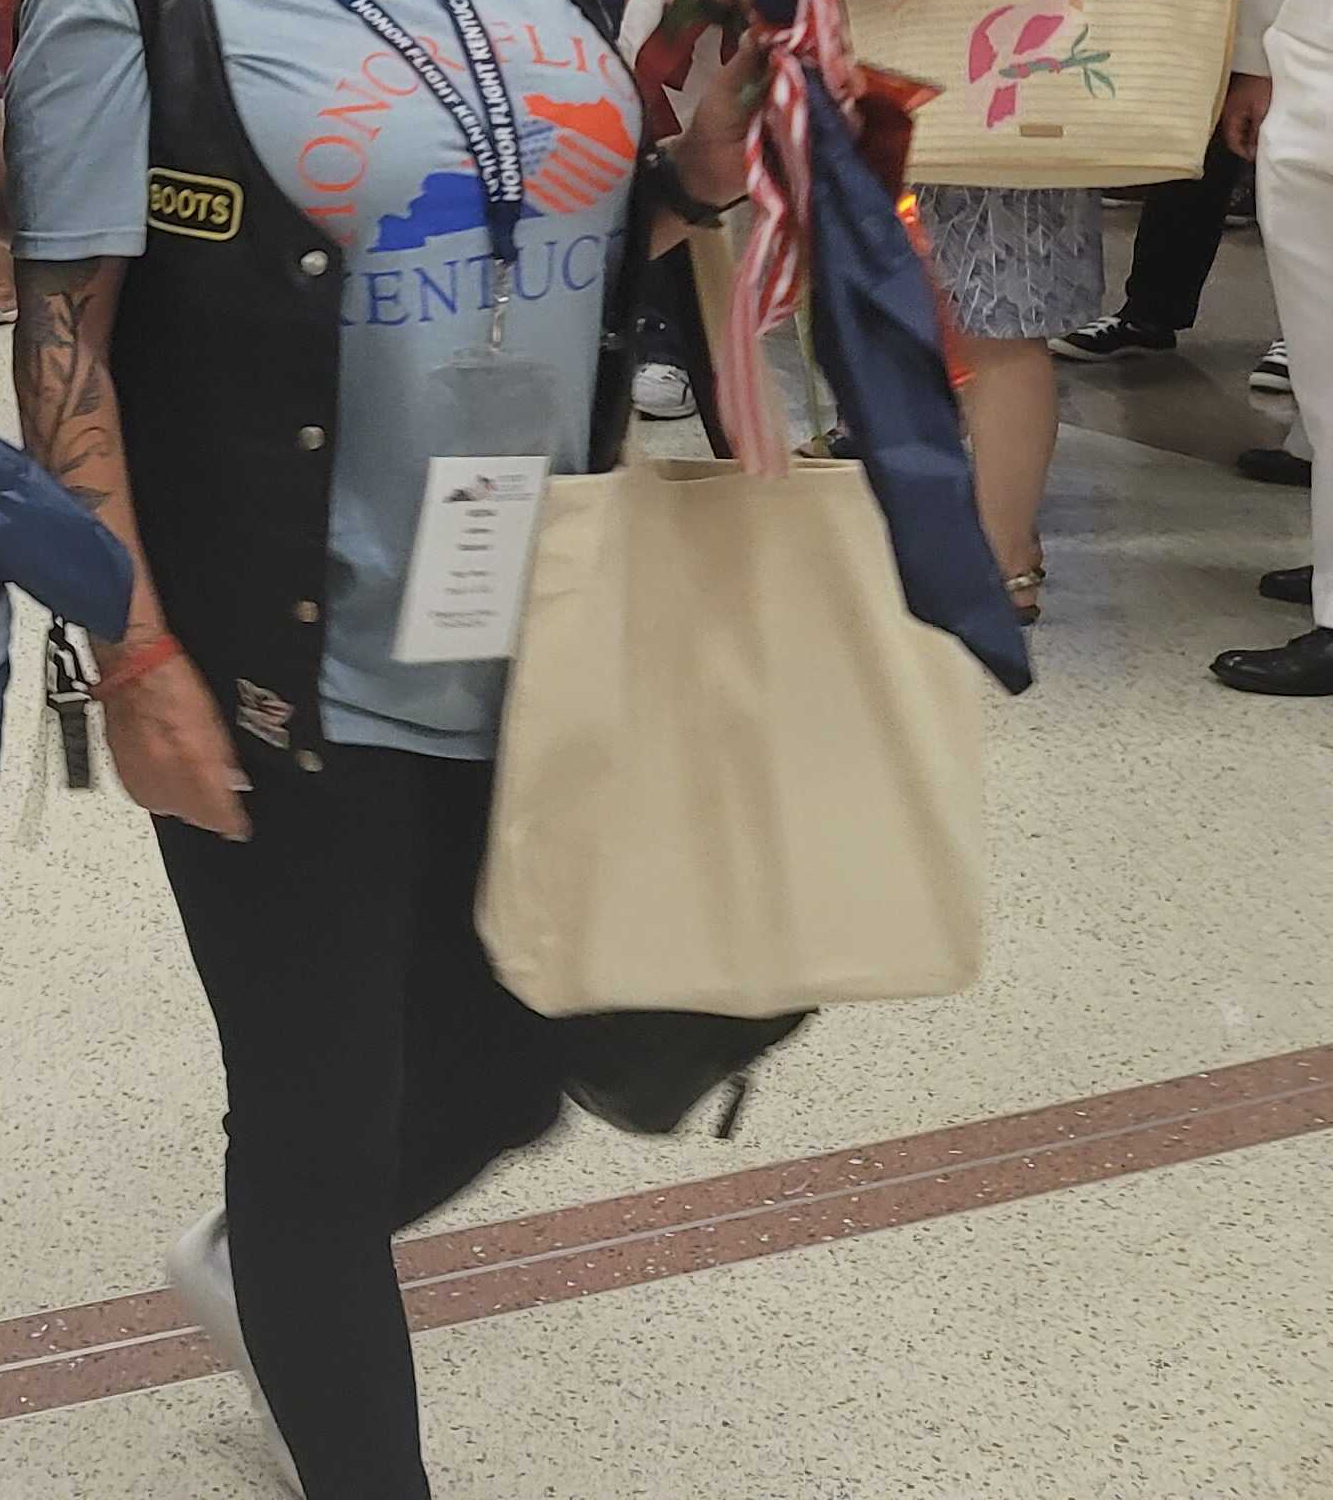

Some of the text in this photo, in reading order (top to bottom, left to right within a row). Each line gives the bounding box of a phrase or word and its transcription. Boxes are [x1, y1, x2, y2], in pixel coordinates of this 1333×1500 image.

[404, 41, 463, 104] FLIGHT
[494, 127, 523, 202] HONOR
[149, 183, 231, 226] BOOTS
